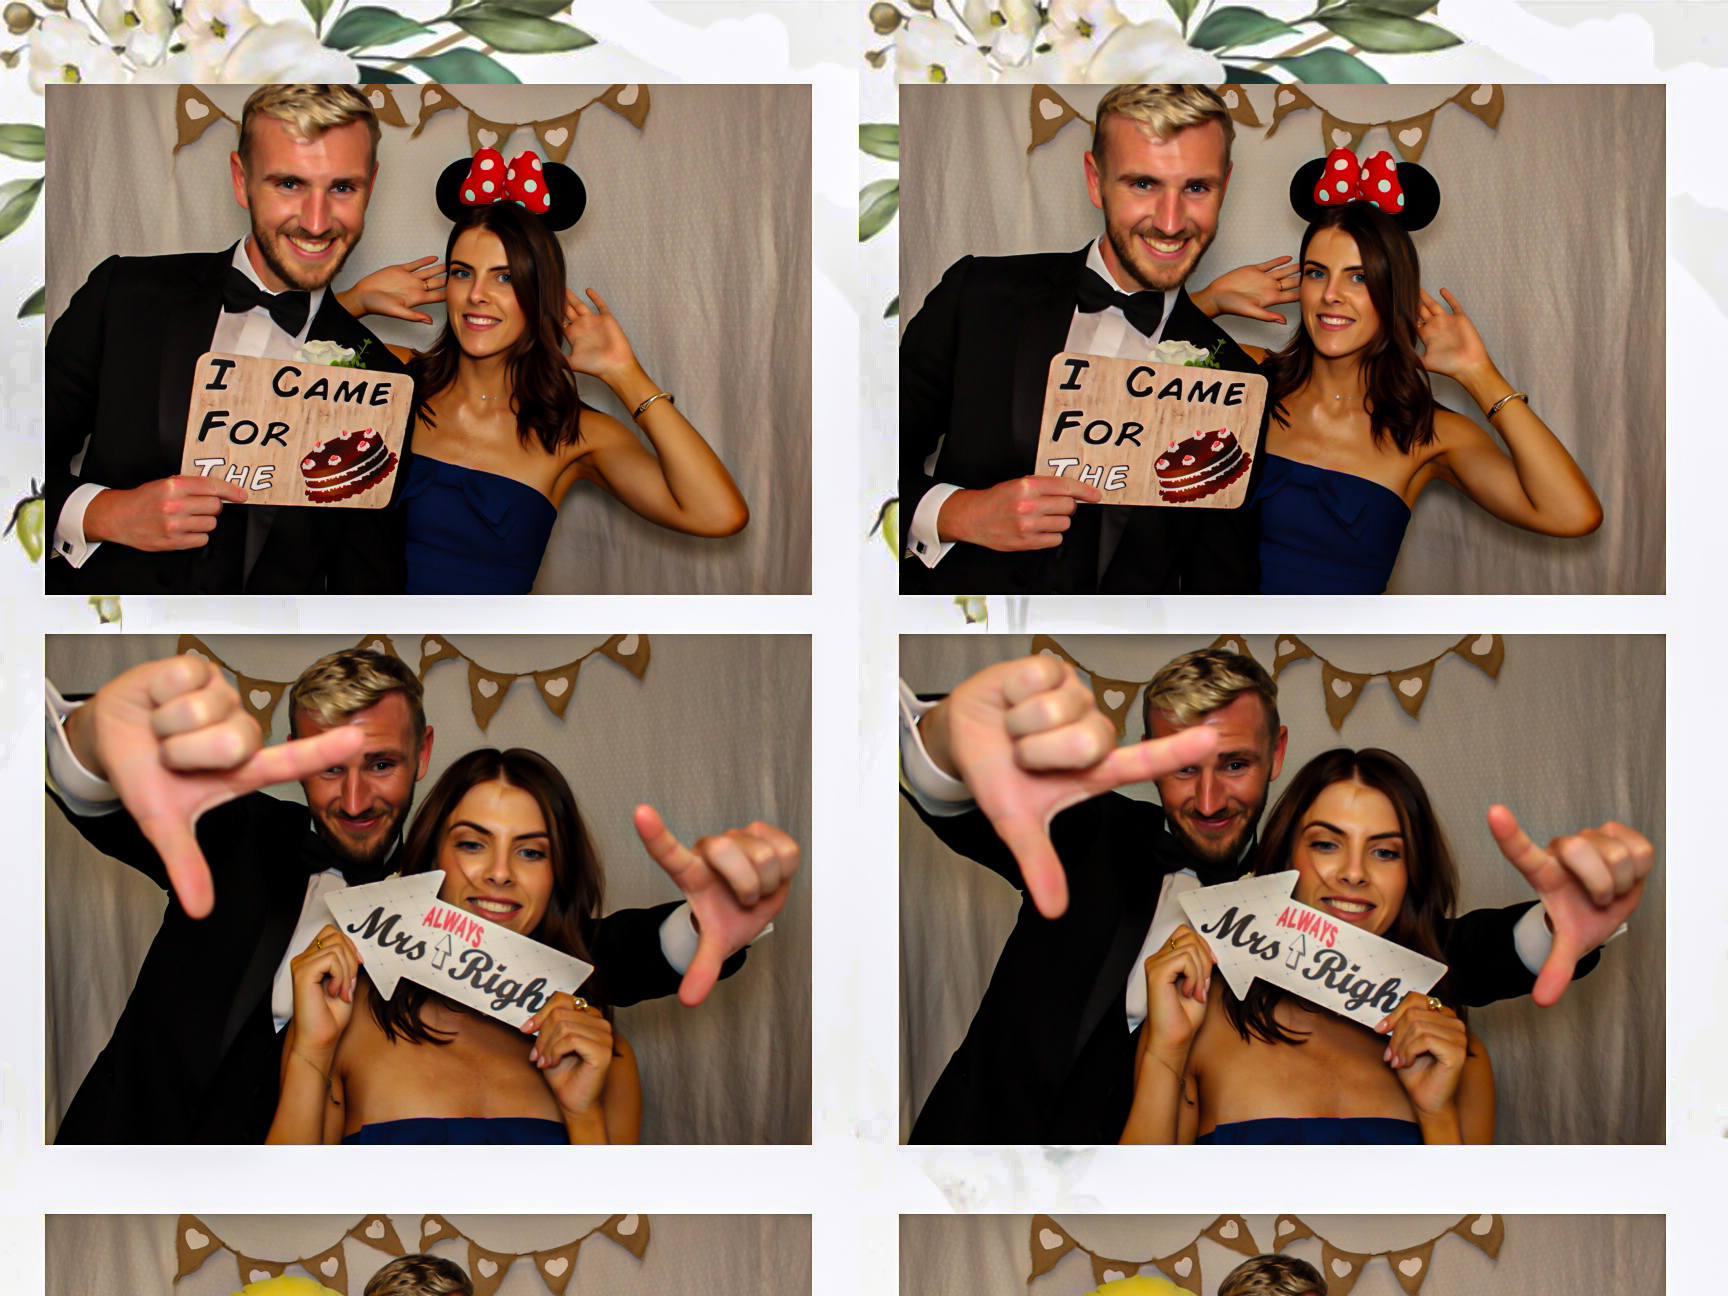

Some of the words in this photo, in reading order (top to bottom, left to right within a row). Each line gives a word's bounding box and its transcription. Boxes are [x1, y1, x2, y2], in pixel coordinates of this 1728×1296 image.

[205, 358, 236, 390] I
[272, 366, 392, 406] CAME
[1059, 358, 1090, 390] I
[1126, 366, 1246, 406] CAME
[197, 410, 290, 447] FOR
[1051, 410, 1144, 447] FOR
[422, 906, 485, 948] ALWAYS
[1276, 906, 1339, 948] ALWAYS
[347, 906, 427, 961] Mrs
[448, 948, 553, 1014] Righ
[1201, 906, 1281, 961] Mrs
[1302, 948, 1407, 1014] Righ
